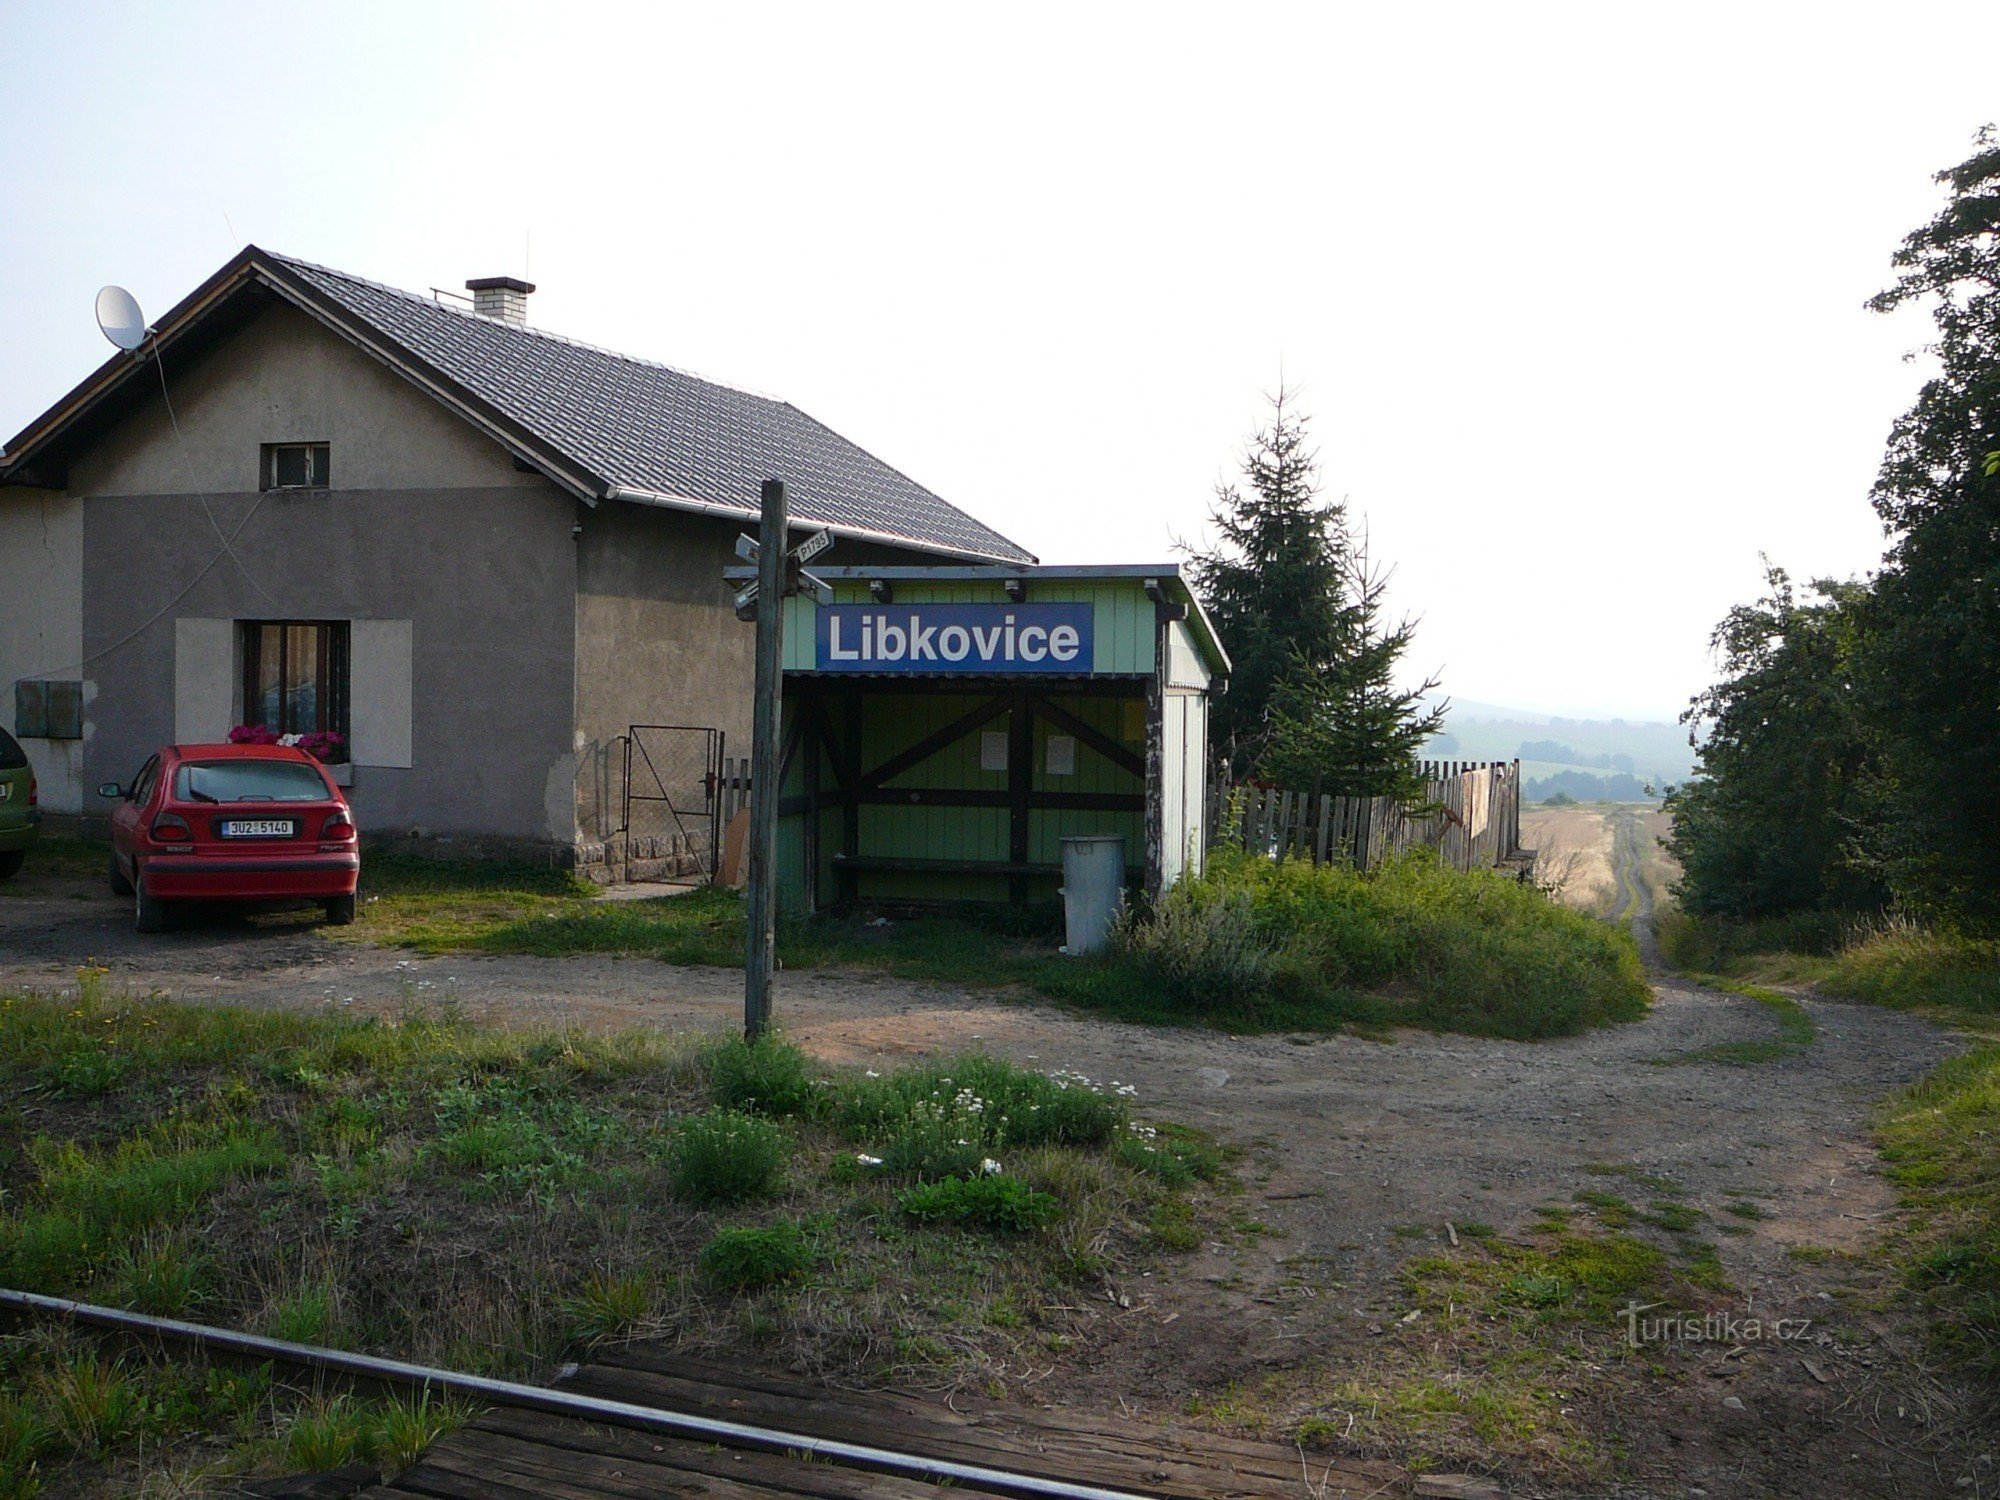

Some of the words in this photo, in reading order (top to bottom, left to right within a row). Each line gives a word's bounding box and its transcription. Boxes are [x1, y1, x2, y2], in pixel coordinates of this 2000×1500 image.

[801, 534, 826, 559] P1795
[830, 615, 1080, 661] Libkovice
[231, 823, 252, 833] 3U2
[261, 822, 288, 833] 5140
